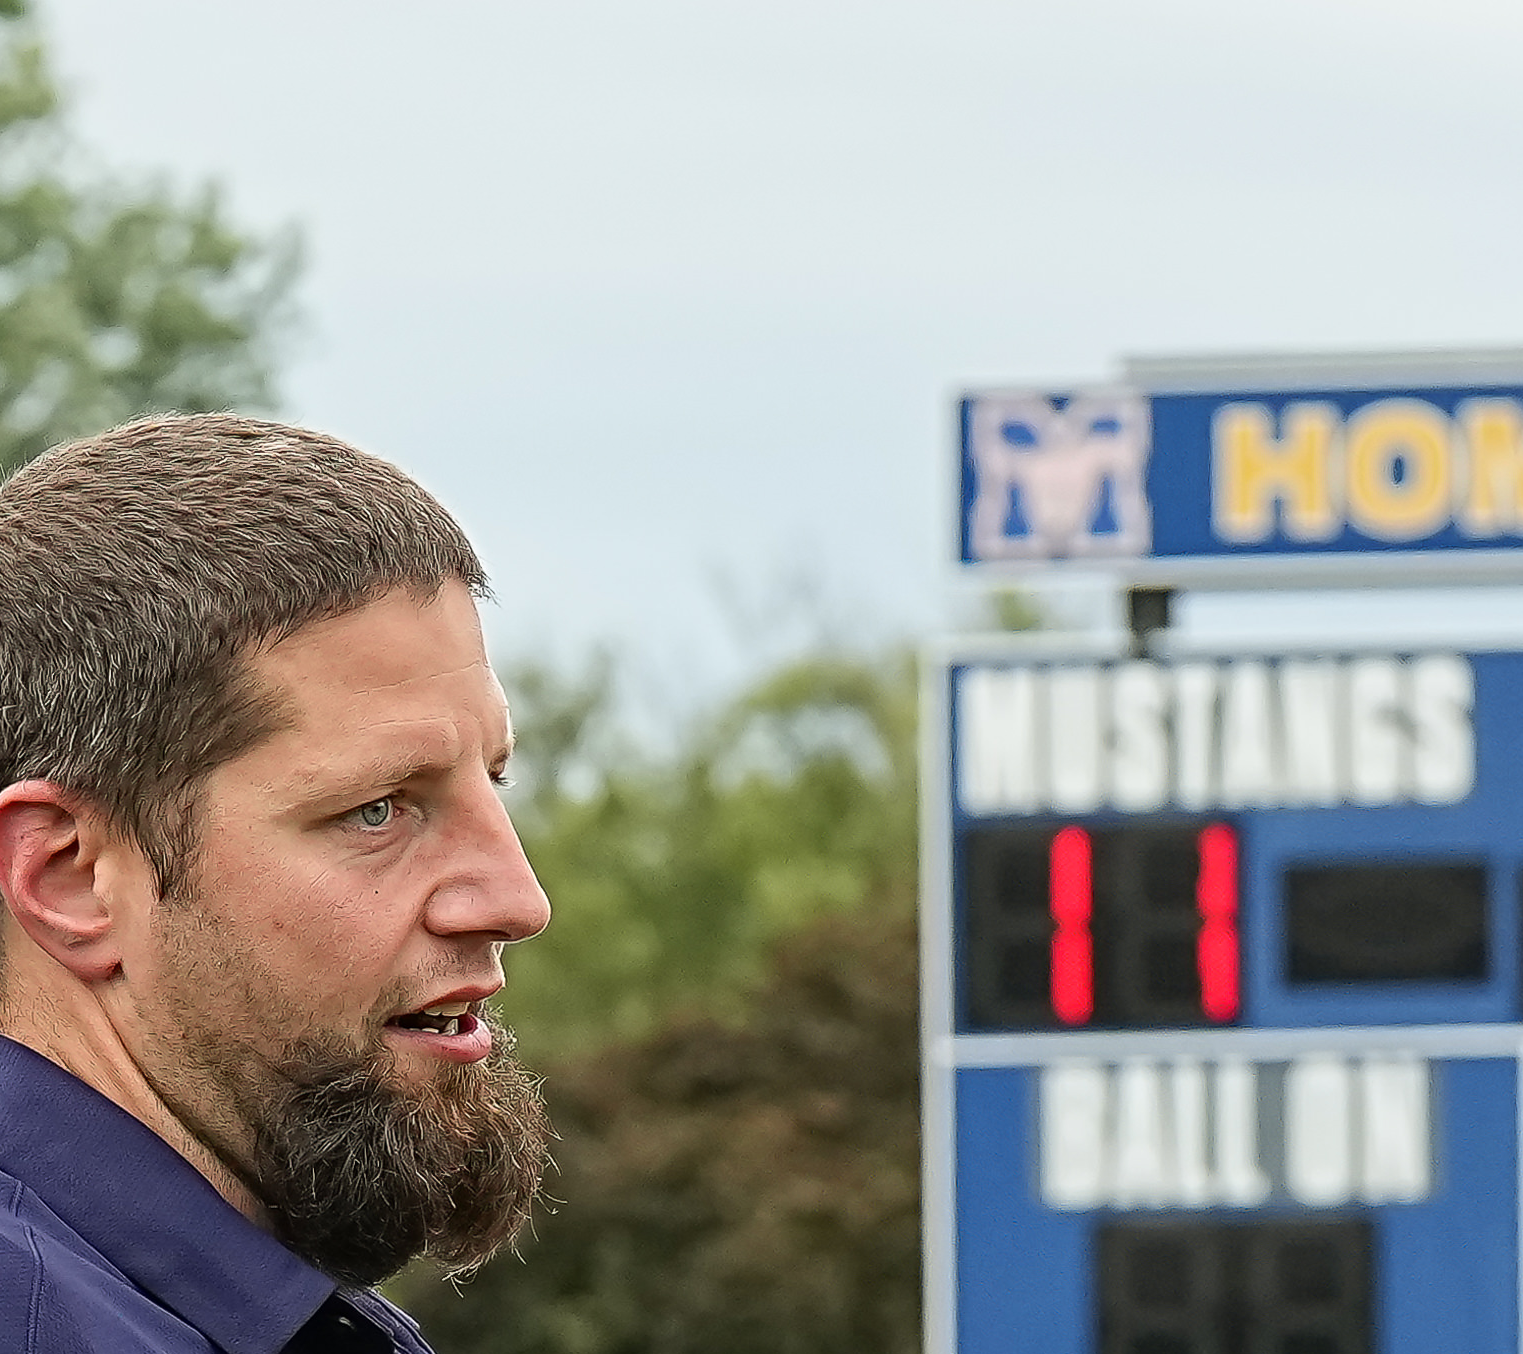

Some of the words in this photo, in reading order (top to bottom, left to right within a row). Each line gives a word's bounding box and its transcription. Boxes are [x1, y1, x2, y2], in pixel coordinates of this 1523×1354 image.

[957, 652, 1475, 817] MUSTANGS
[1049, 823, 1241, 1026] 11
[1037, 1054, 1272, 1210] BALL
[1283, 1051, 1435, 1206] ON
